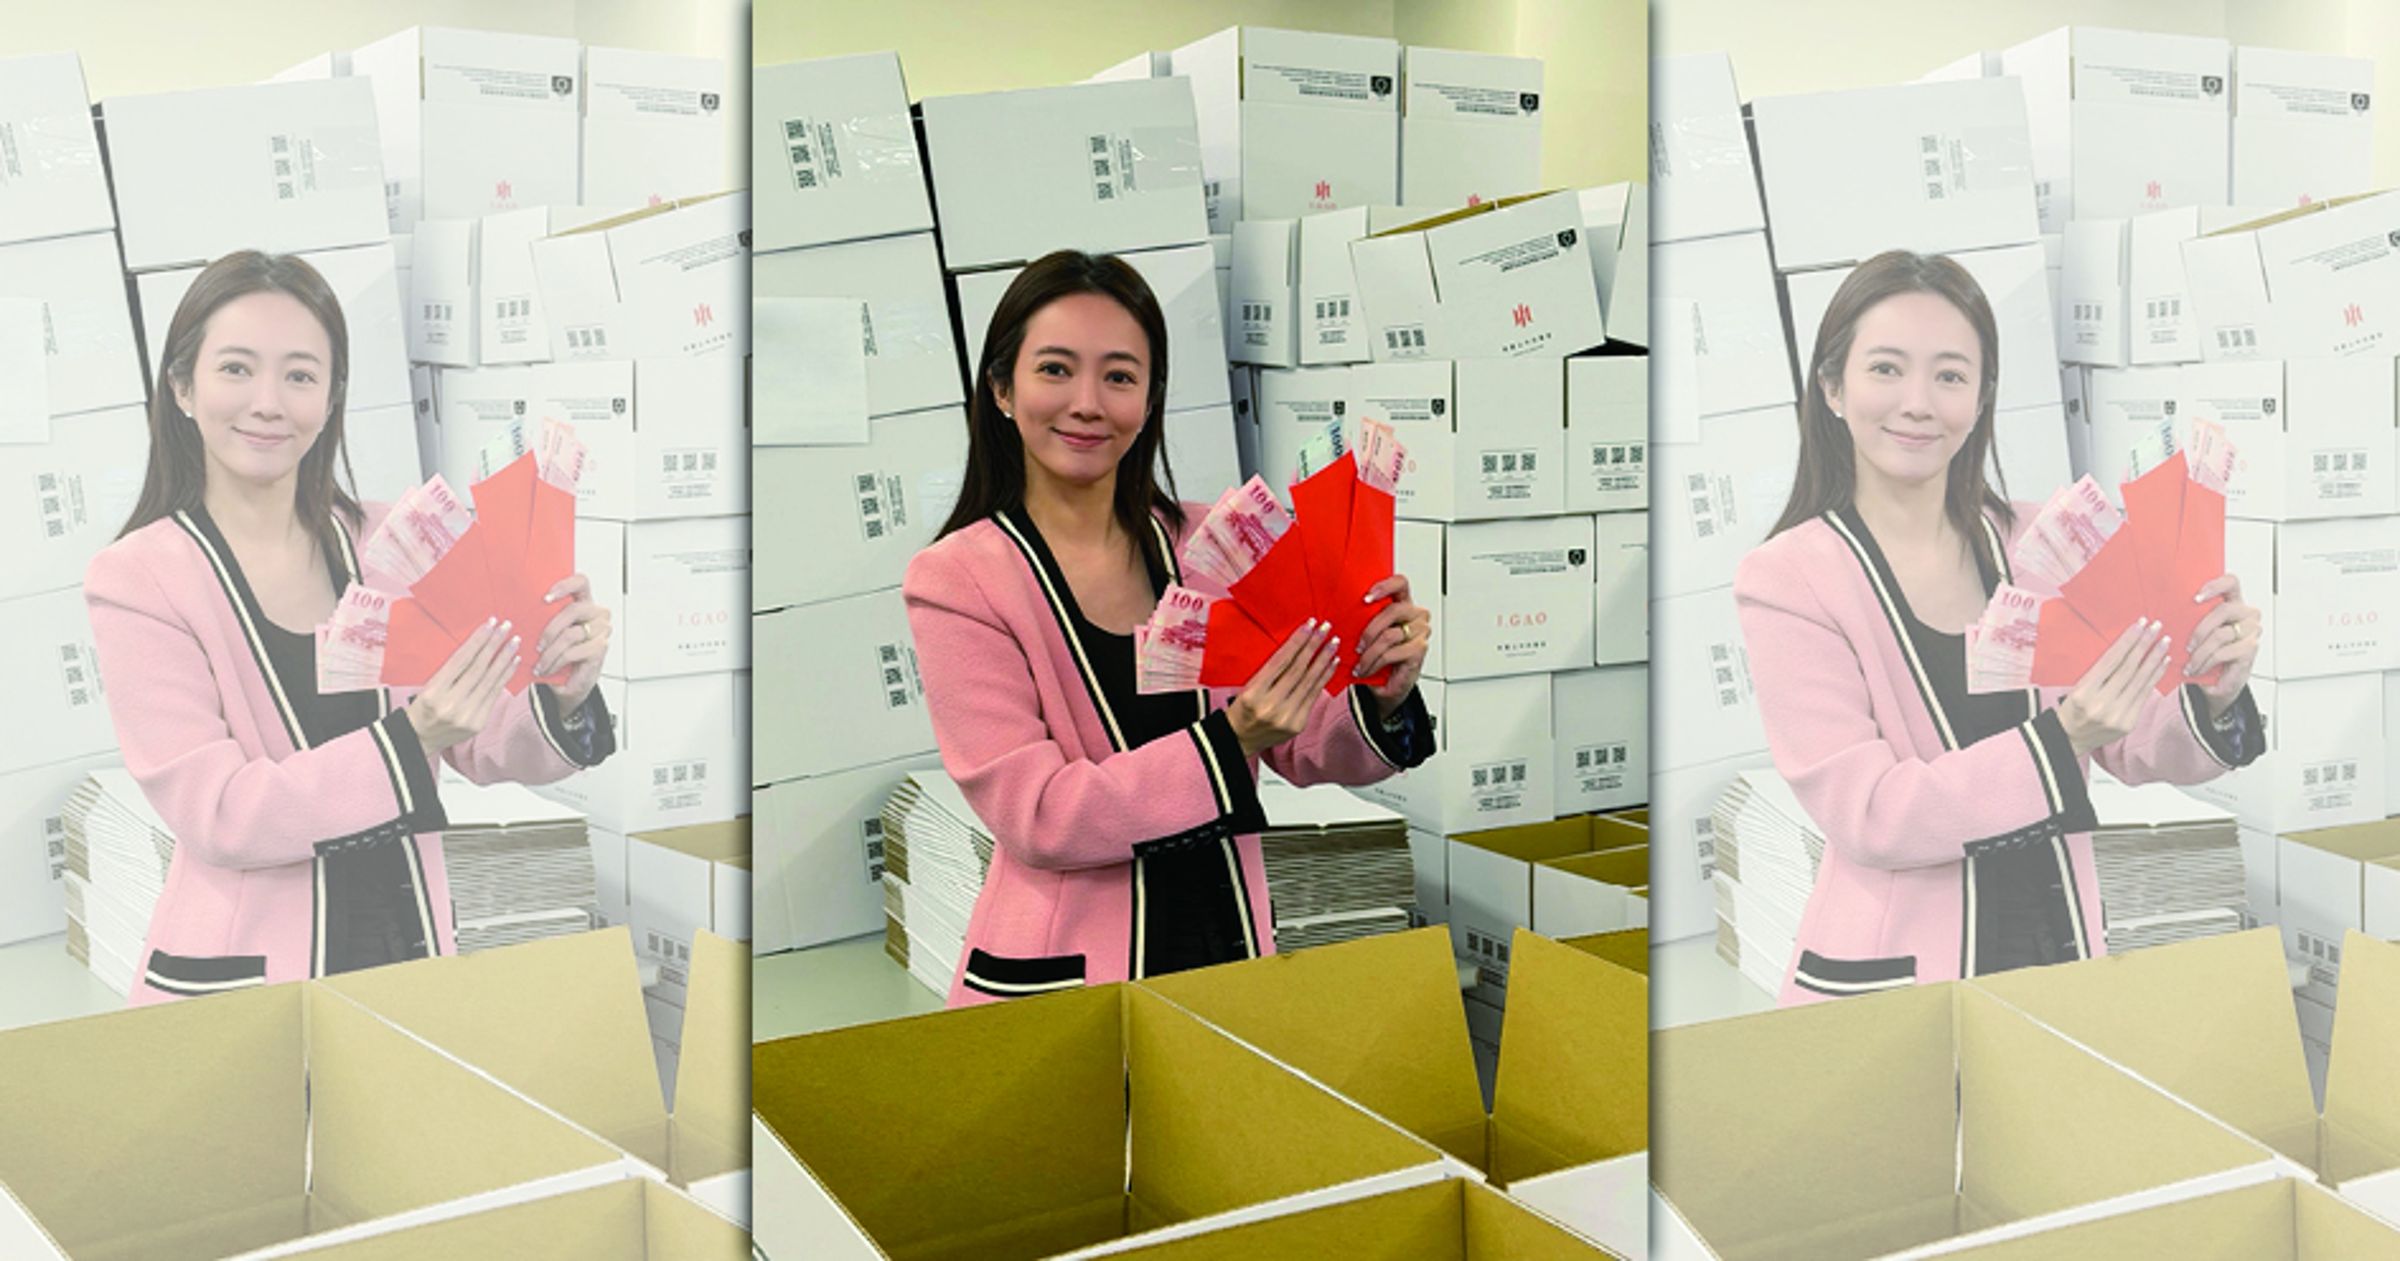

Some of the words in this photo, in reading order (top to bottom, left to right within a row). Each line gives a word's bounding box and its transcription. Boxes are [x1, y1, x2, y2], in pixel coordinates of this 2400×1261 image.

[430, 483, 456, 513] 100
[1249, 484, 1275, 514] 100
[2080, 483, 2106, 513] 100
[349, 590, 385, 612] 100
[1168, 591, 1204, 613] 100
[1999, 590, 2035, 612] 100
